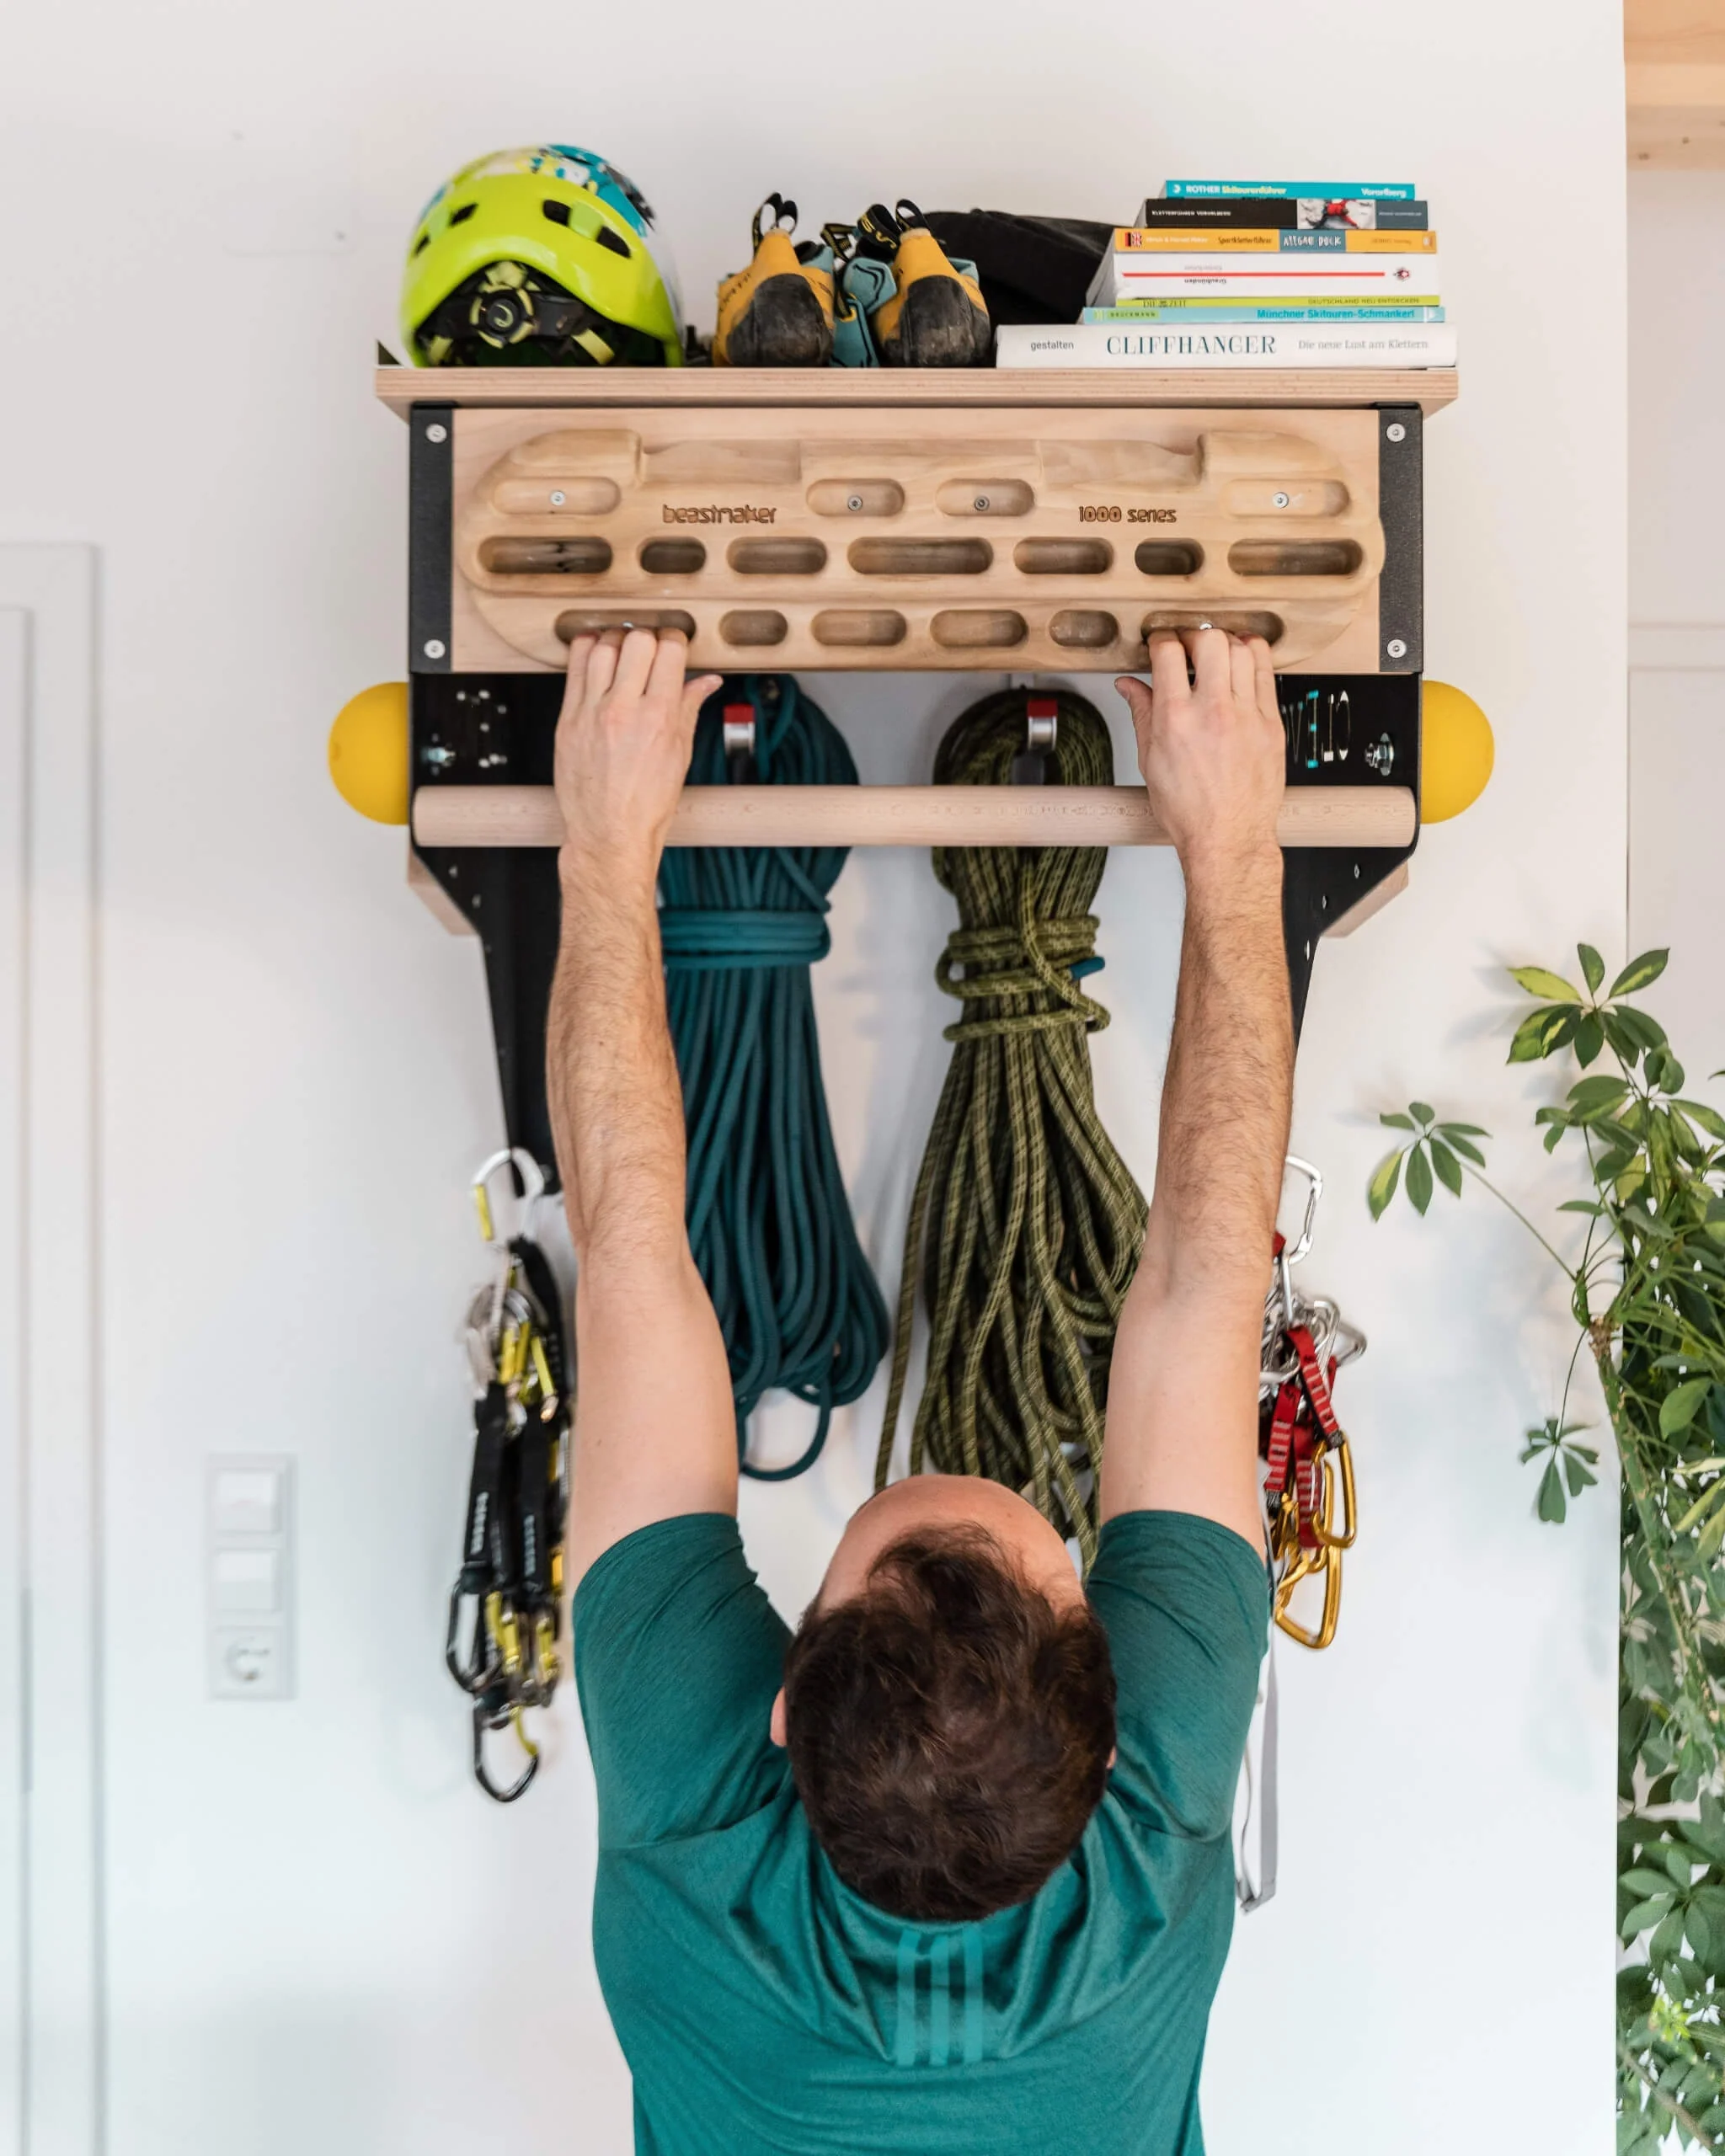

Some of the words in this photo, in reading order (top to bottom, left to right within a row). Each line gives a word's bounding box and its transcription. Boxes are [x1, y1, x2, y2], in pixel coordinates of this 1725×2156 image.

[1186, 184, 1220, 194] ROTHER
[1257, 308, 1305, 319] Münchner
[1307, 309, 1414, 319] Skitouren-Schmankerl
[1030, 340, 1075, 352] gestalten
[1107, 335, 1277, 355] CLIFFHANGER
[1298, 339, 1316, 350] Die
[1344, 339, 1366, 350] Lust
[1388, 339, 1429, 350] Klettern
[662, 504, 777, 524] beastmaker
[1079, 506, 1122, 523] 1000
[1127, 509, 1177, 523] series
